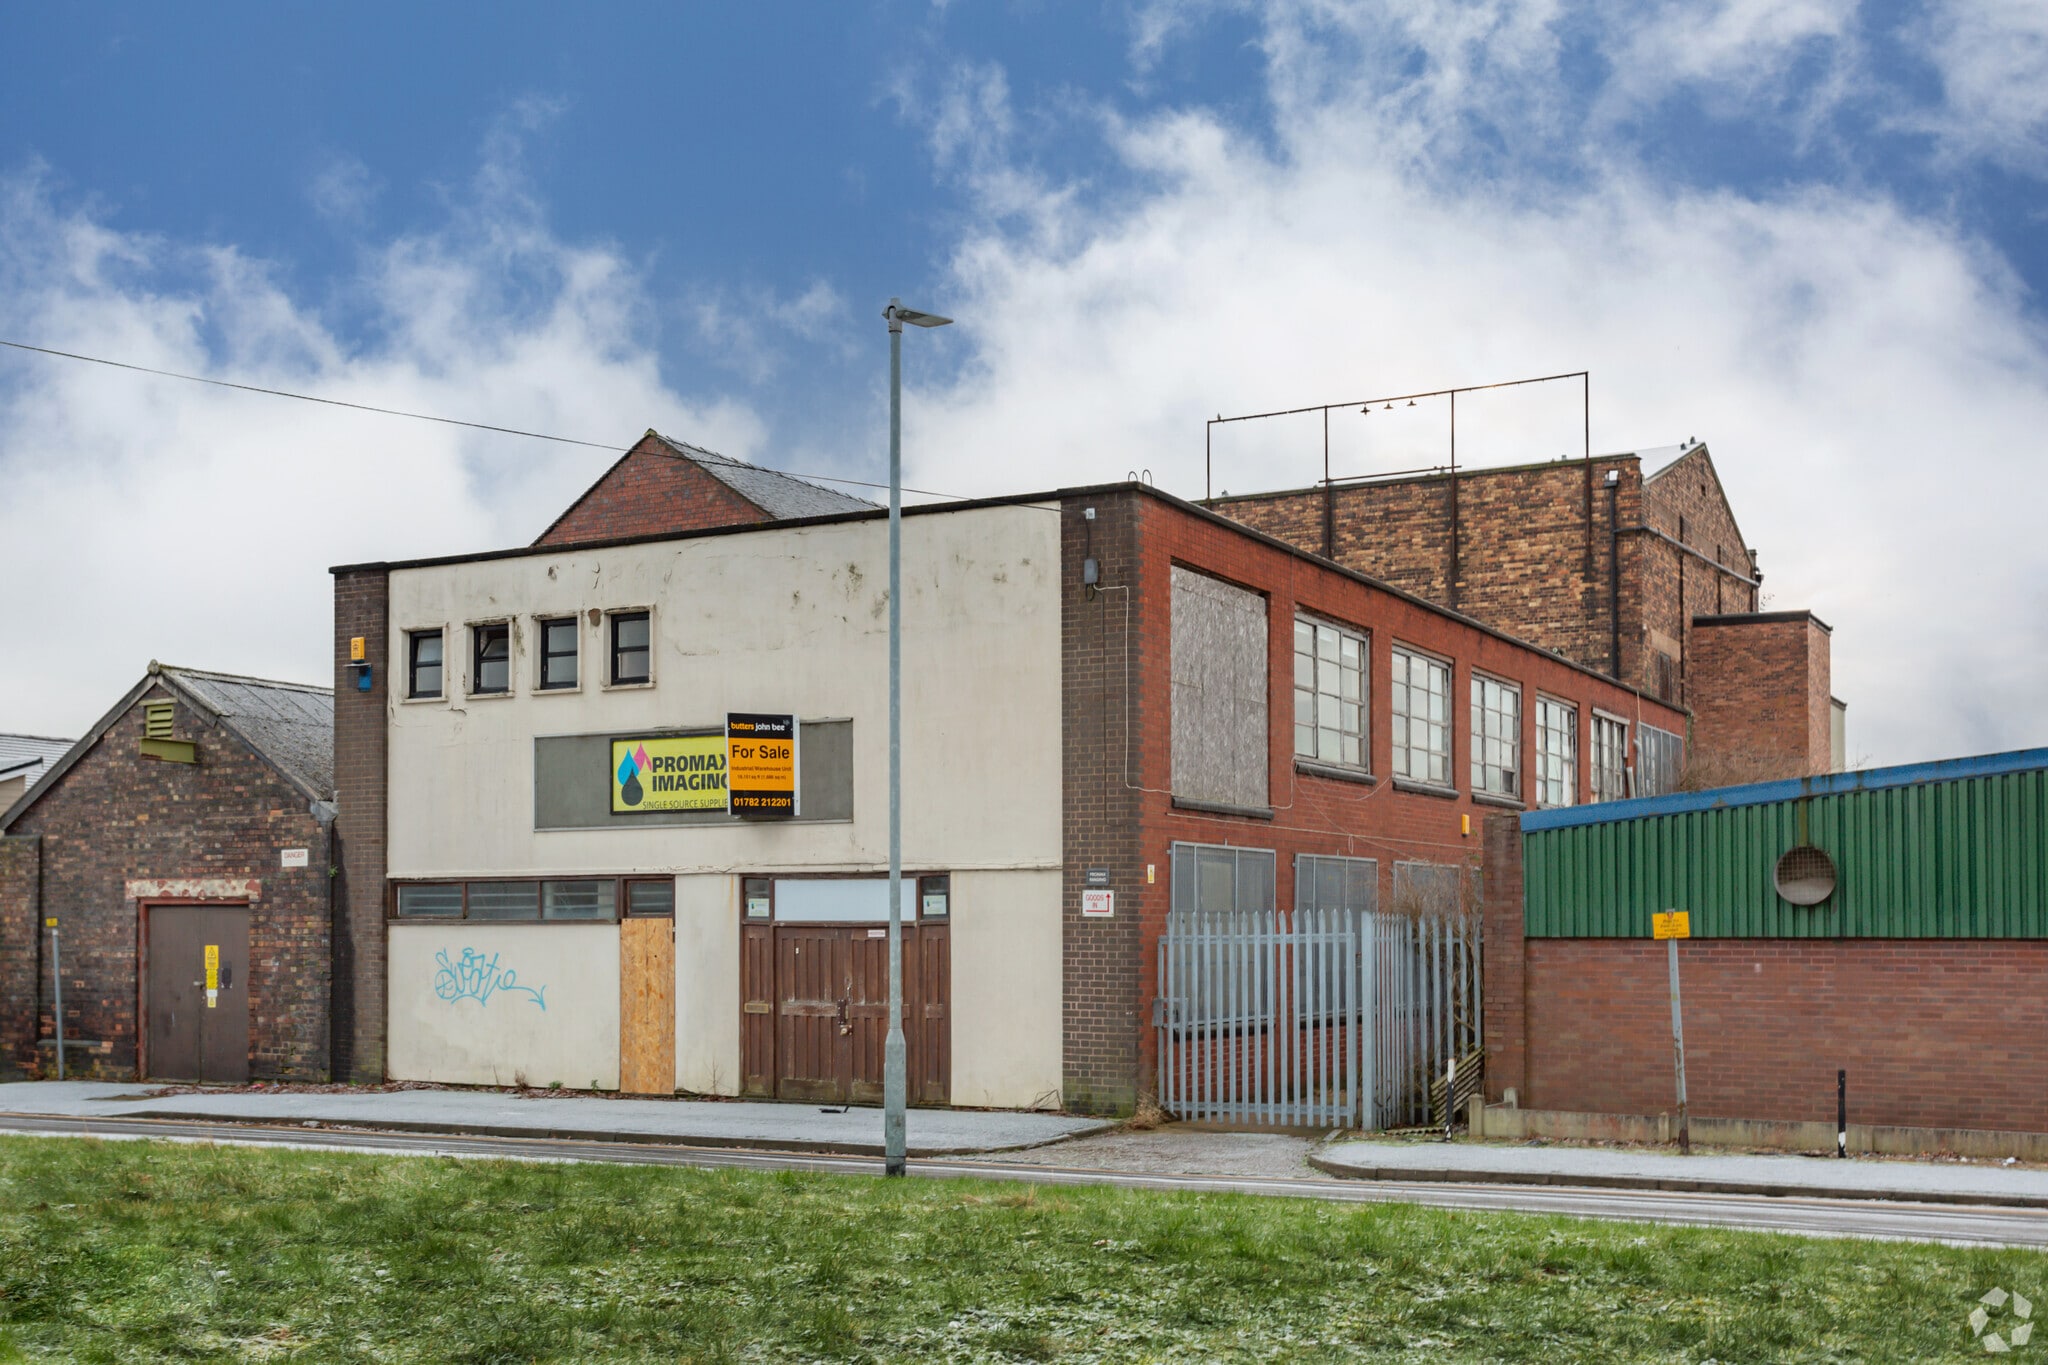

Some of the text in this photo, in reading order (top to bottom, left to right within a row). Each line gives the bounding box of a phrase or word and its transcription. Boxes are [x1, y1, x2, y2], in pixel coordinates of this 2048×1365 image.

[730, 721, 785, 732] butters john bee
[732, 744, 790, 759] For Sale
[642, 798, 728, 809] SINGLE SOURCE SUPPLIE
[734, 797, 791, 807] 01782 212201
[1085, 894, 1104, 902] GOODS
